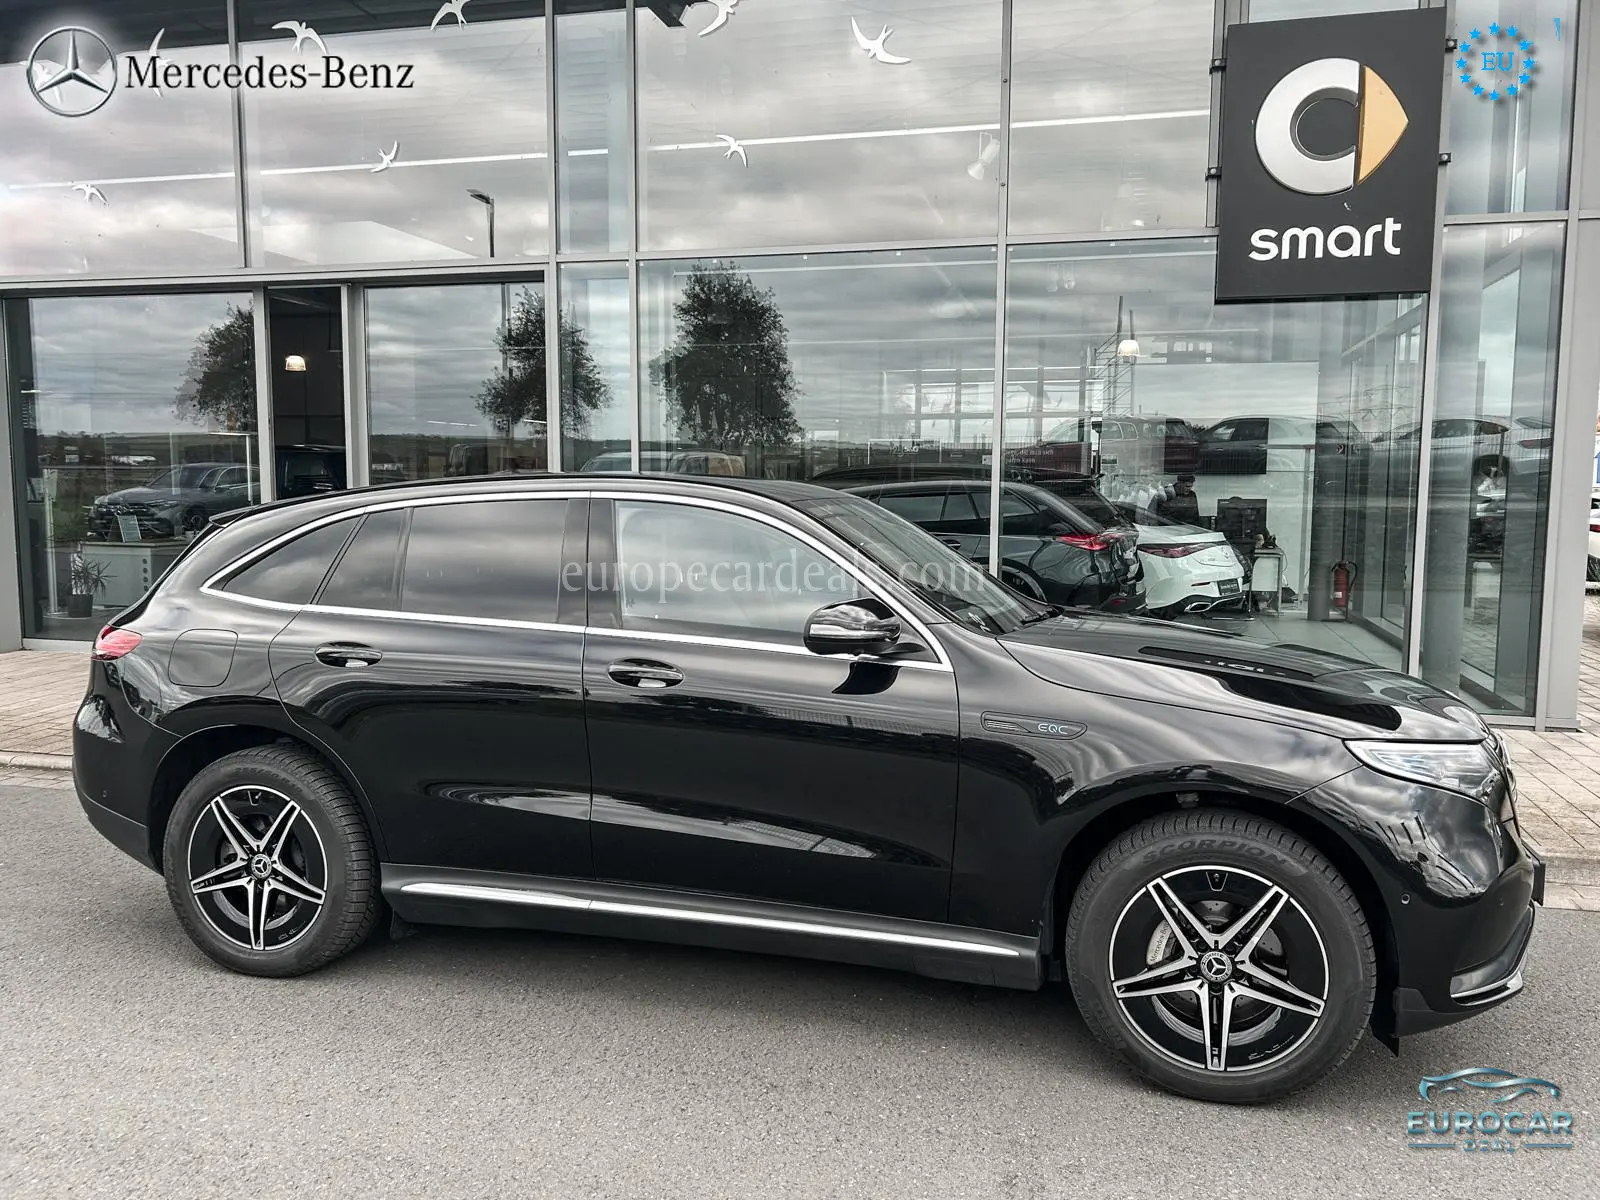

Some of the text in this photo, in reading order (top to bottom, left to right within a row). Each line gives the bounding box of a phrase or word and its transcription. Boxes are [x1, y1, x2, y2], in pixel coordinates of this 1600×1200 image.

[1248, 217, 1402, 262] smart
[1038, 723, 1068, 735] EQC
[1142, 839, 1286, 864] SCORPION
